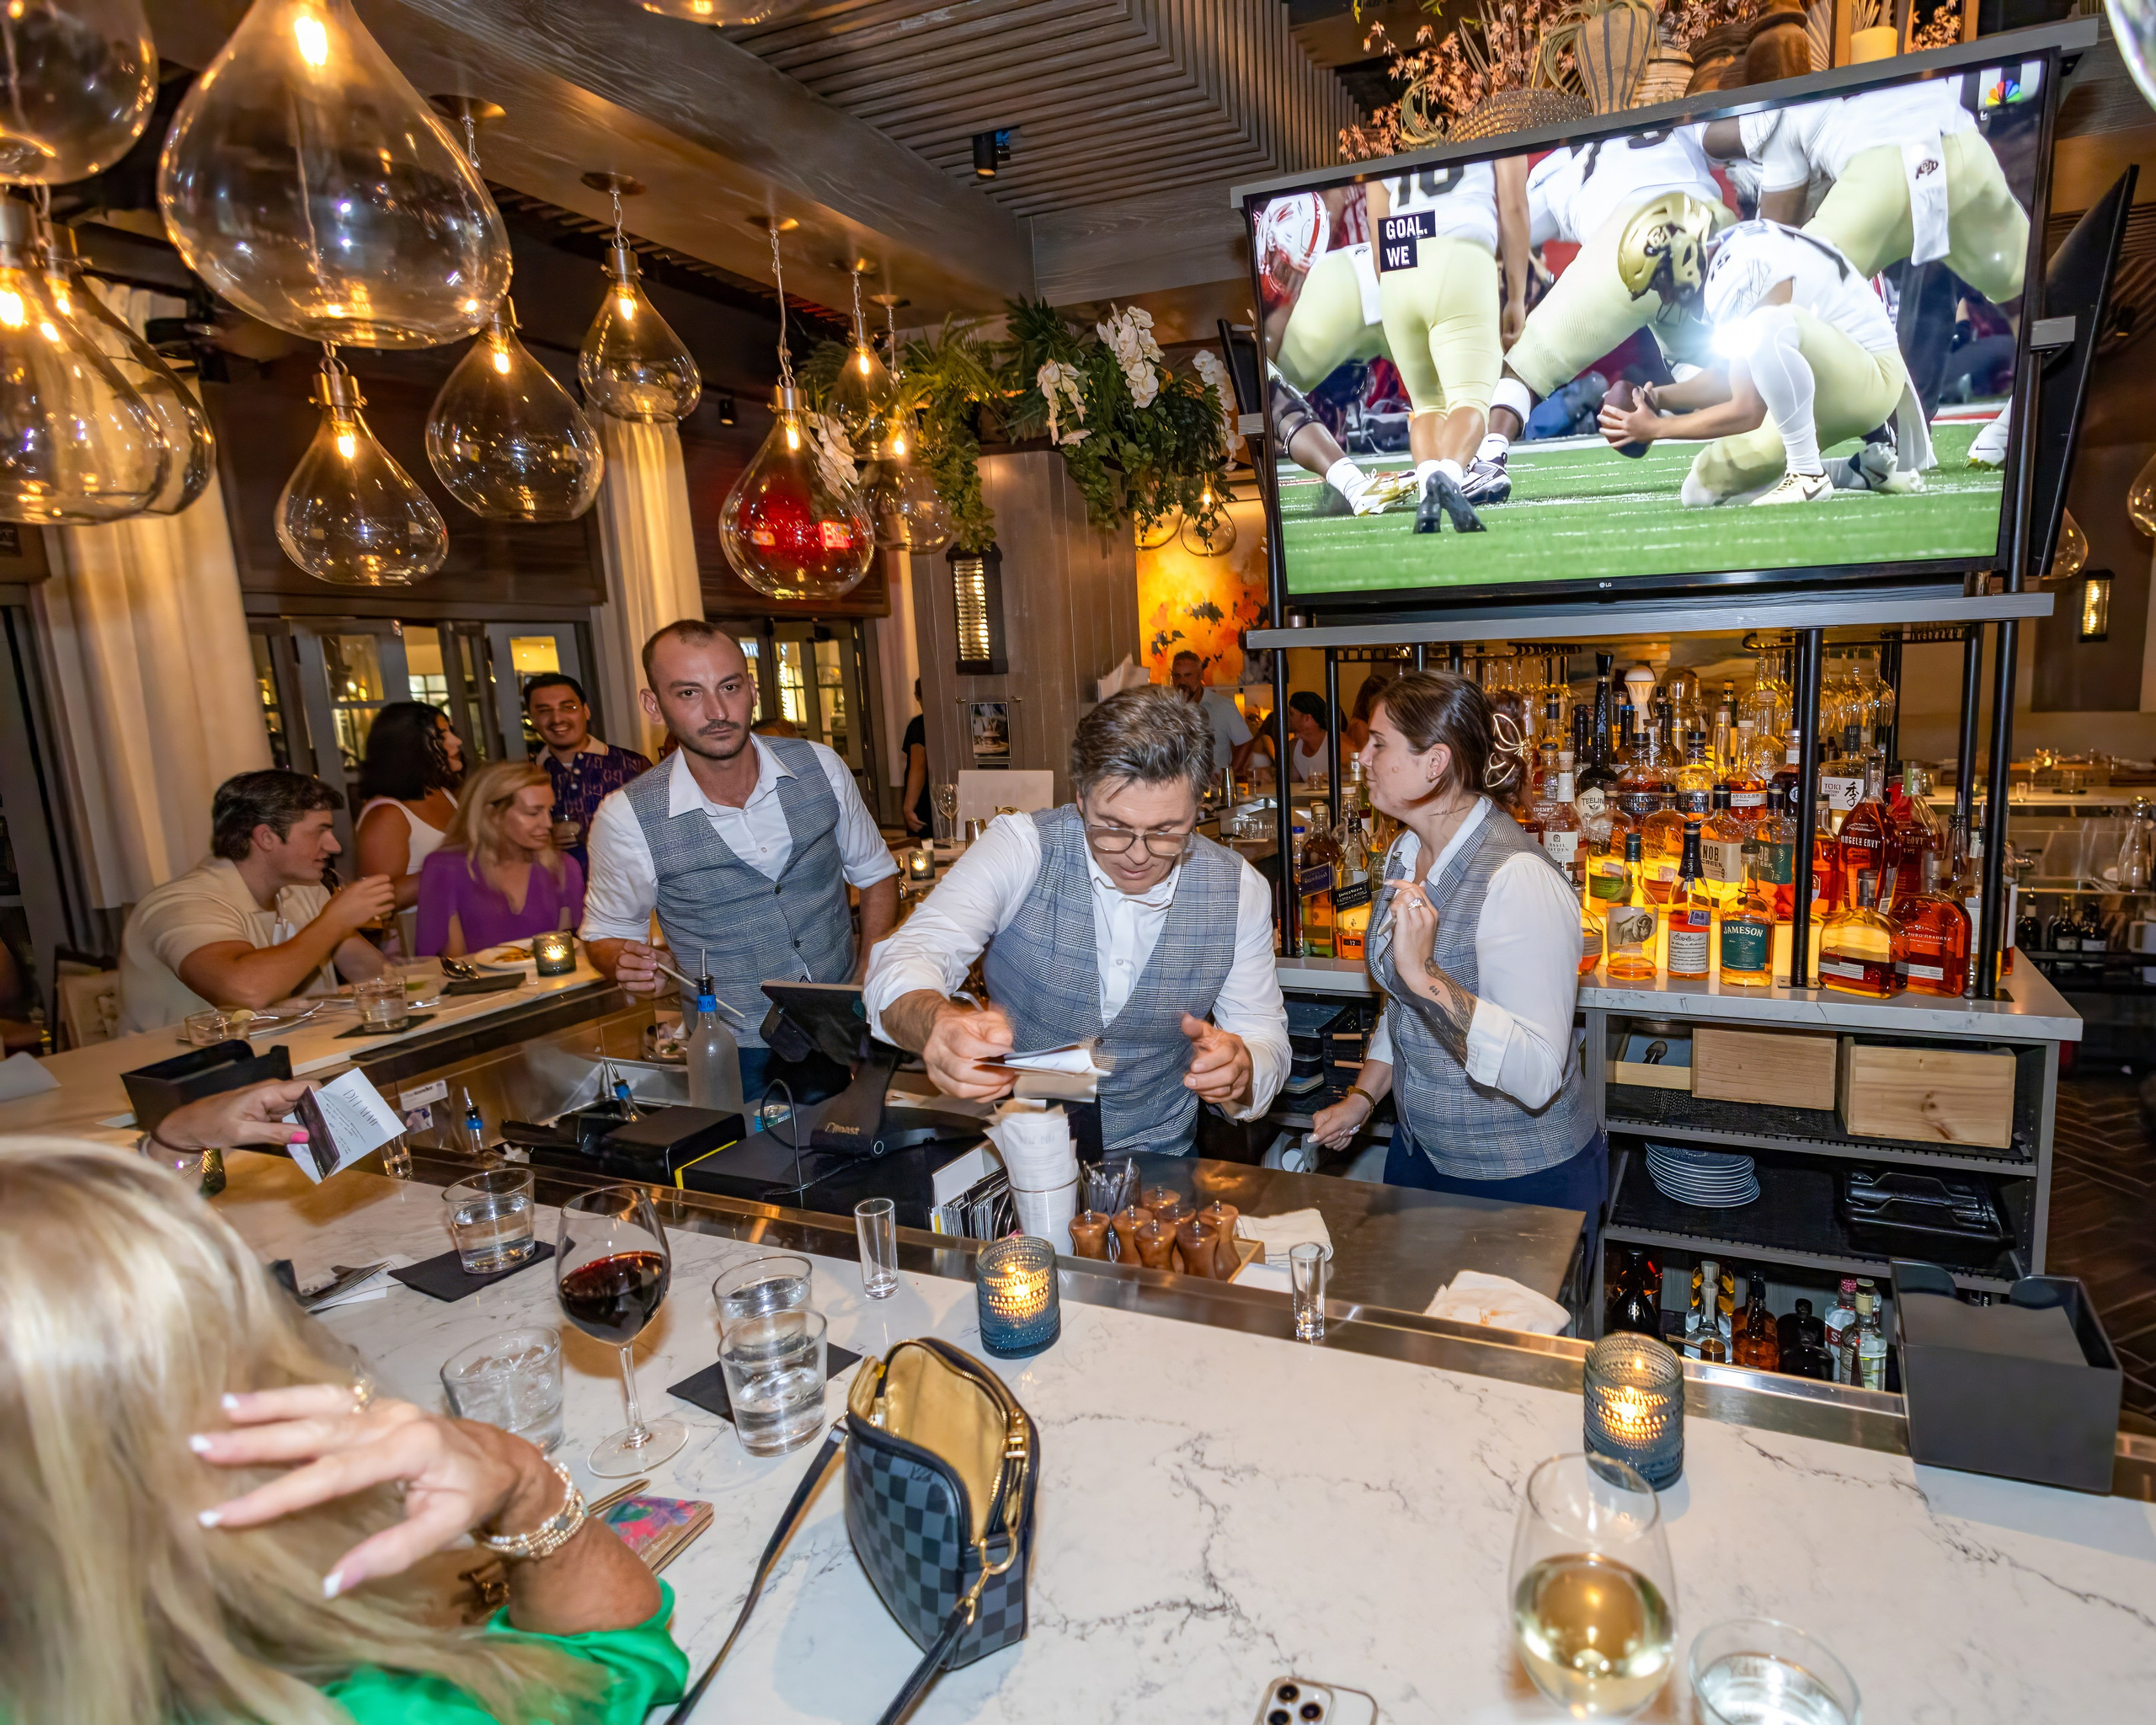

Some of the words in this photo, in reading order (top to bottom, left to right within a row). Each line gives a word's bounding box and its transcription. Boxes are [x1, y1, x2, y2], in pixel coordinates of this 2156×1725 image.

[1385, 216, 1428, 240] GOAL.
[1385, 245, 1411, 268] WE
[1581, 797, 1604, 807] TEELIN
[1700, 845, 1719, 861] NOB
[1758, 846, 1769, 861] OB
[1701, 859, 1723, 868] CREEK
[1759, 861, 1774, 869] EEK
[1723, 926, 1764, 937] JAMESON
